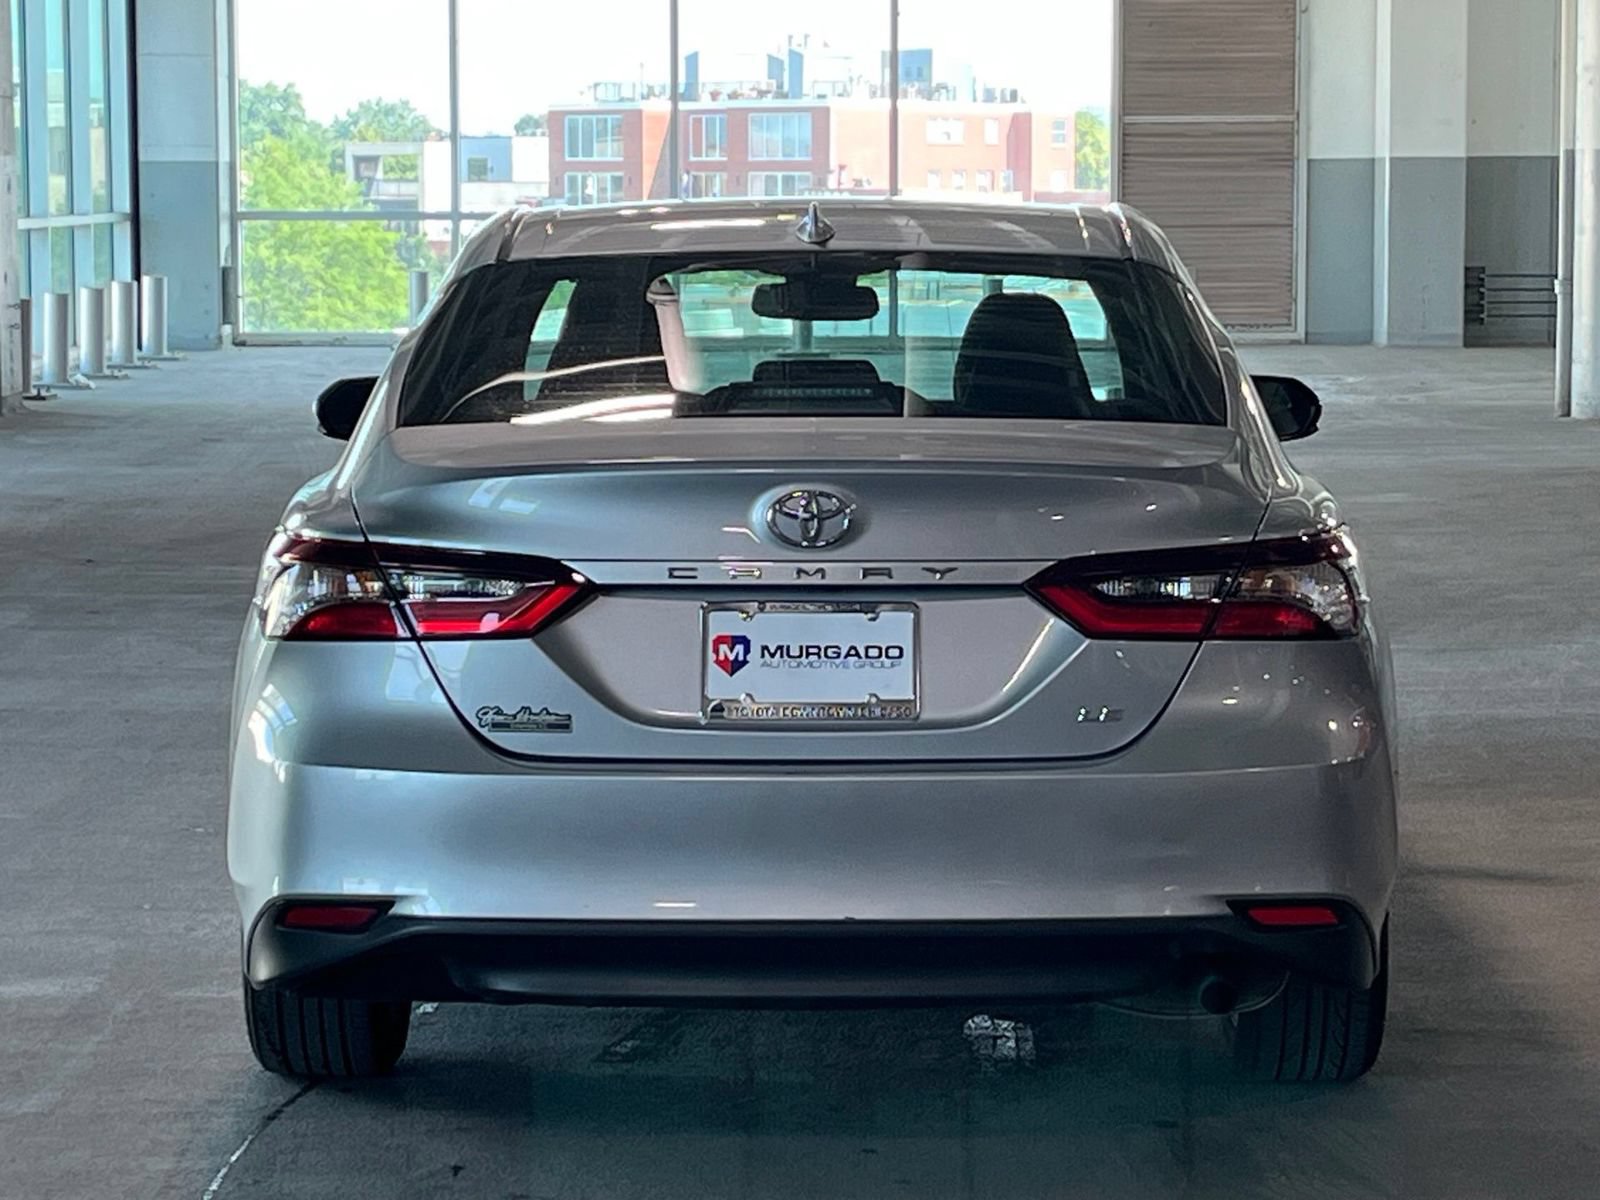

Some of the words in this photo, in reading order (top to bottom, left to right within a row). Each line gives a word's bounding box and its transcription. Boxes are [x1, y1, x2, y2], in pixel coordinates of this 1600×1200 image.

[667, 566, 958, 580] CAMRY
[717, 643, 745, 661] M
[760, 644, 905, 660] MURGADO
[760, 659, 850, 670] AUTOMOTIVE
[852, 659, 902, 670] GROUP
[1076, 706, 1123, 722] LE
